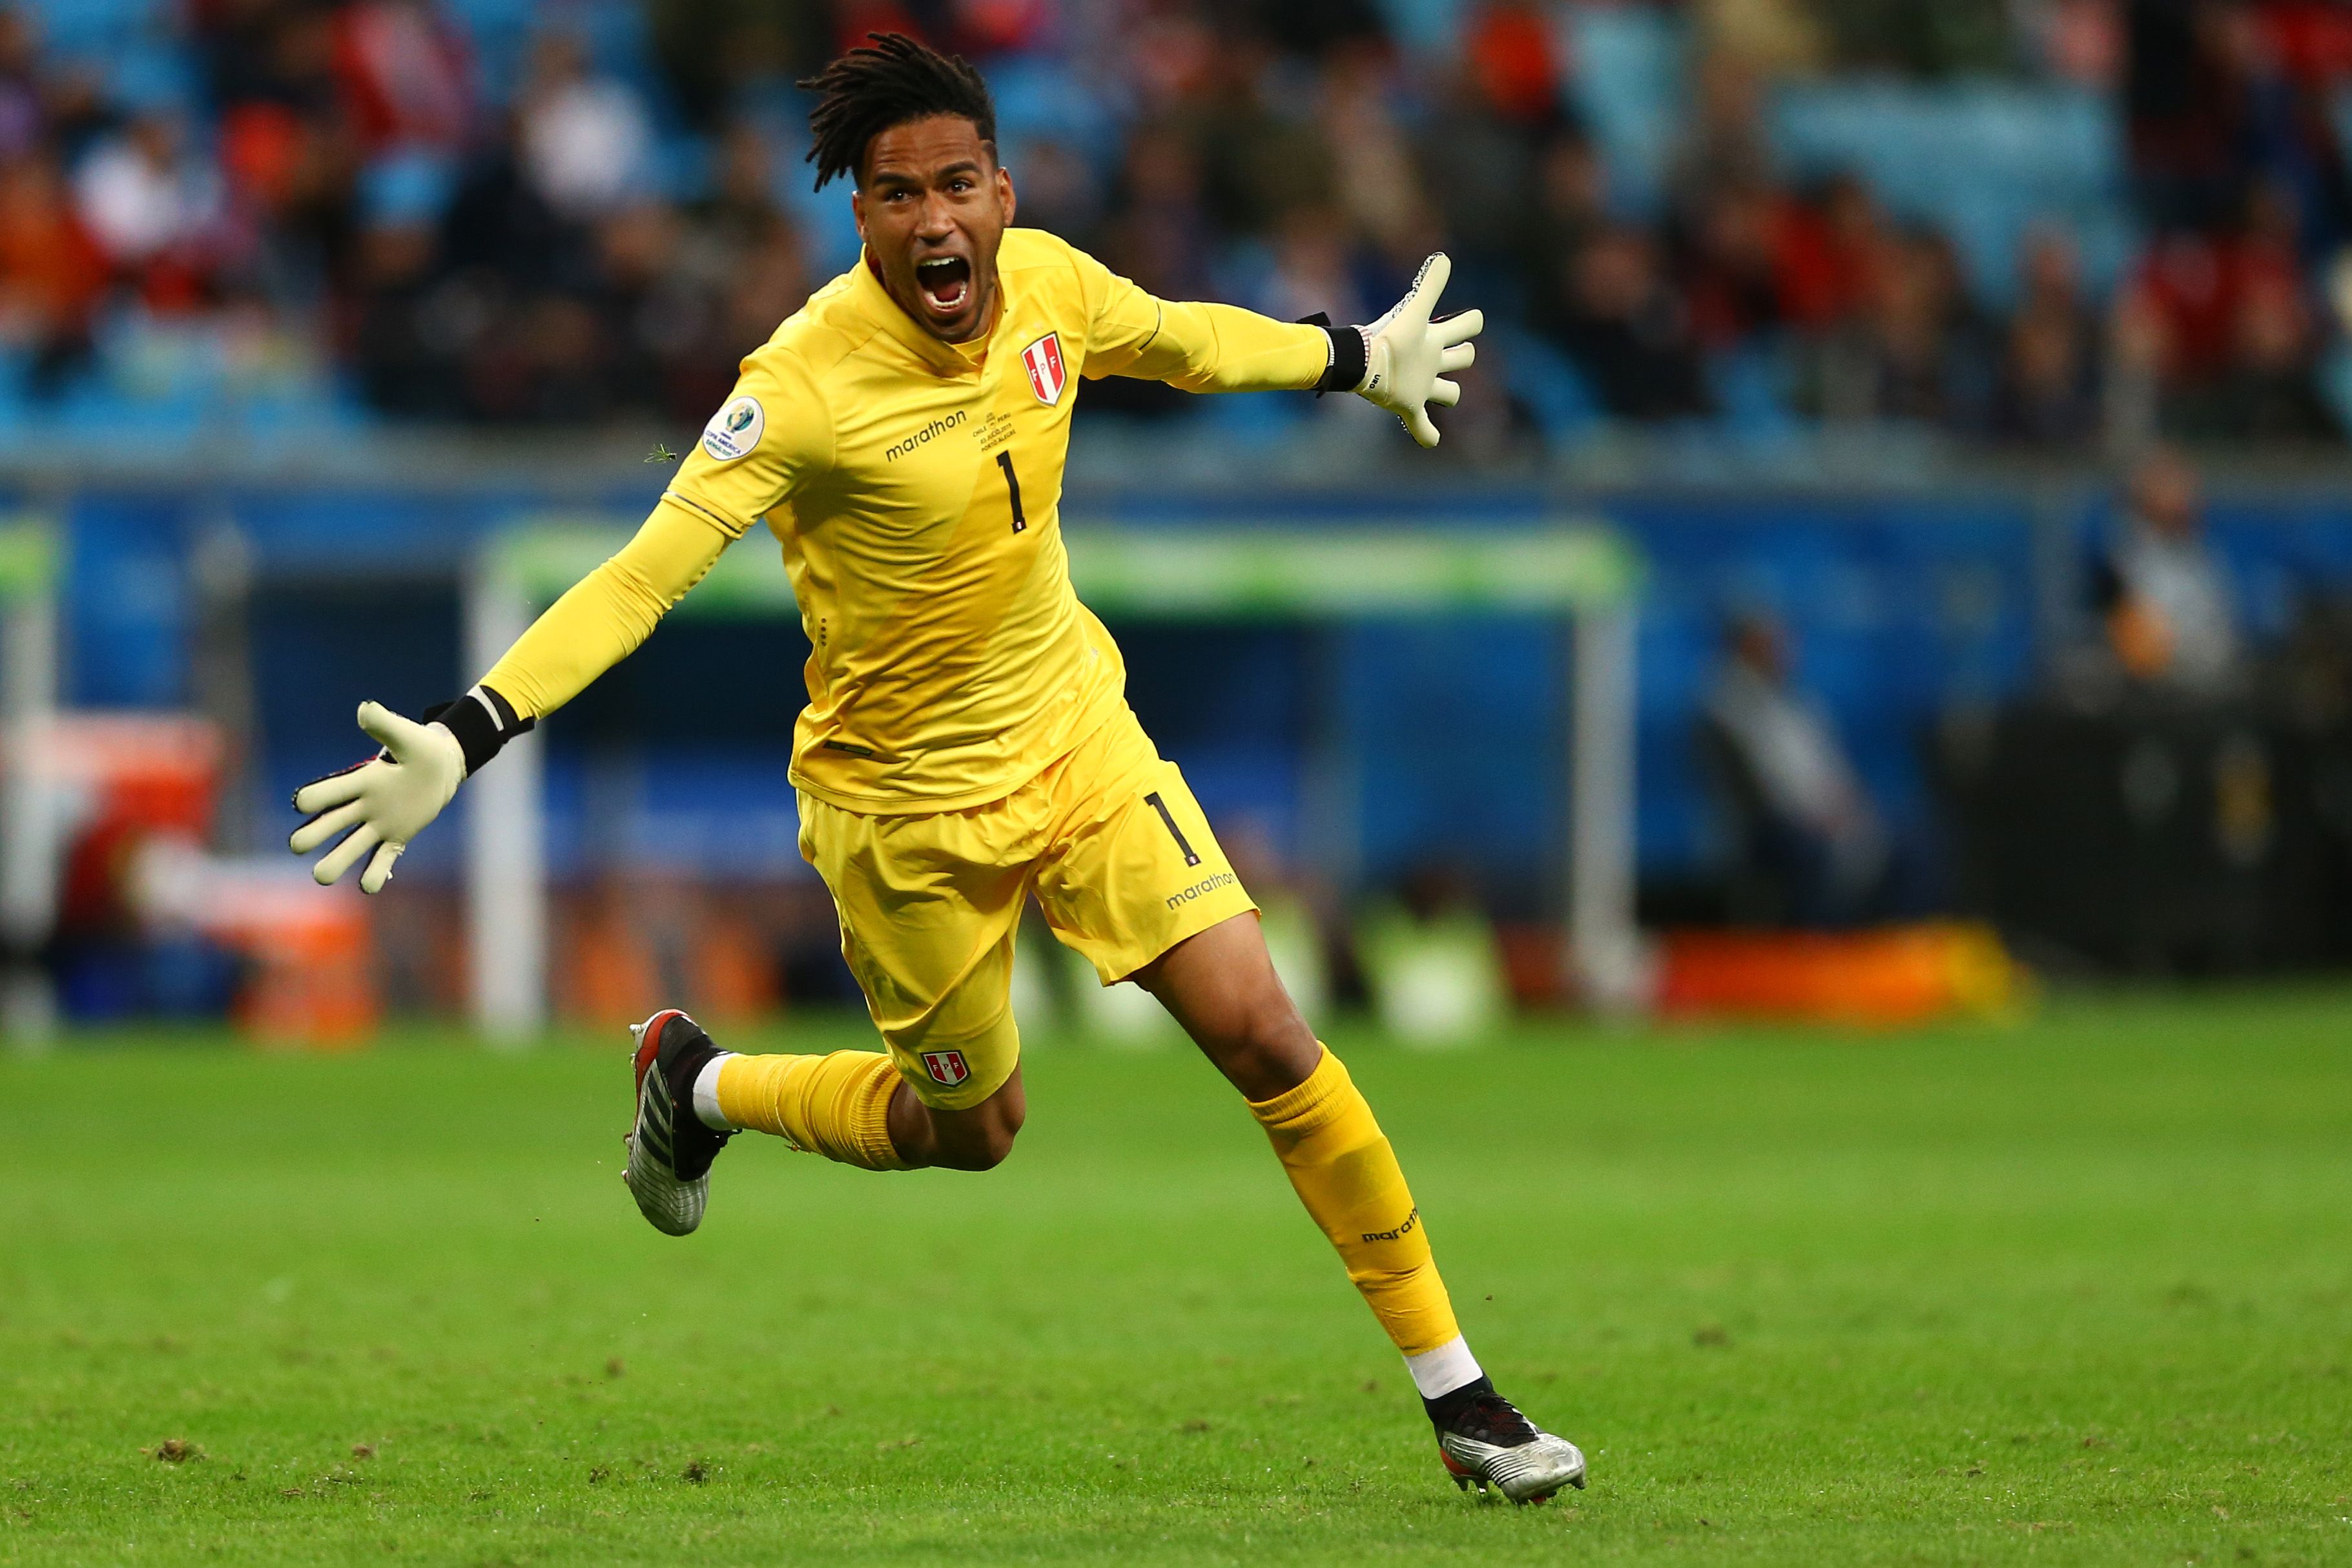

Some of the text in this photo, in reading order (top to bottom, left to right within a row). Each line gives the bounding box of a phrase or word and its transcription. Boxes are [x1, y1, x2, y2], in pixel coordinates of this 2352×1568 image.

[1369, 374, 1381, 389] URG
[885, 410, 967, 462] marathon
[996, 449, 1027, 535] 1
[1143, 791, 1202, 867] 1
[1166, 872, 1236, 911] marathon
